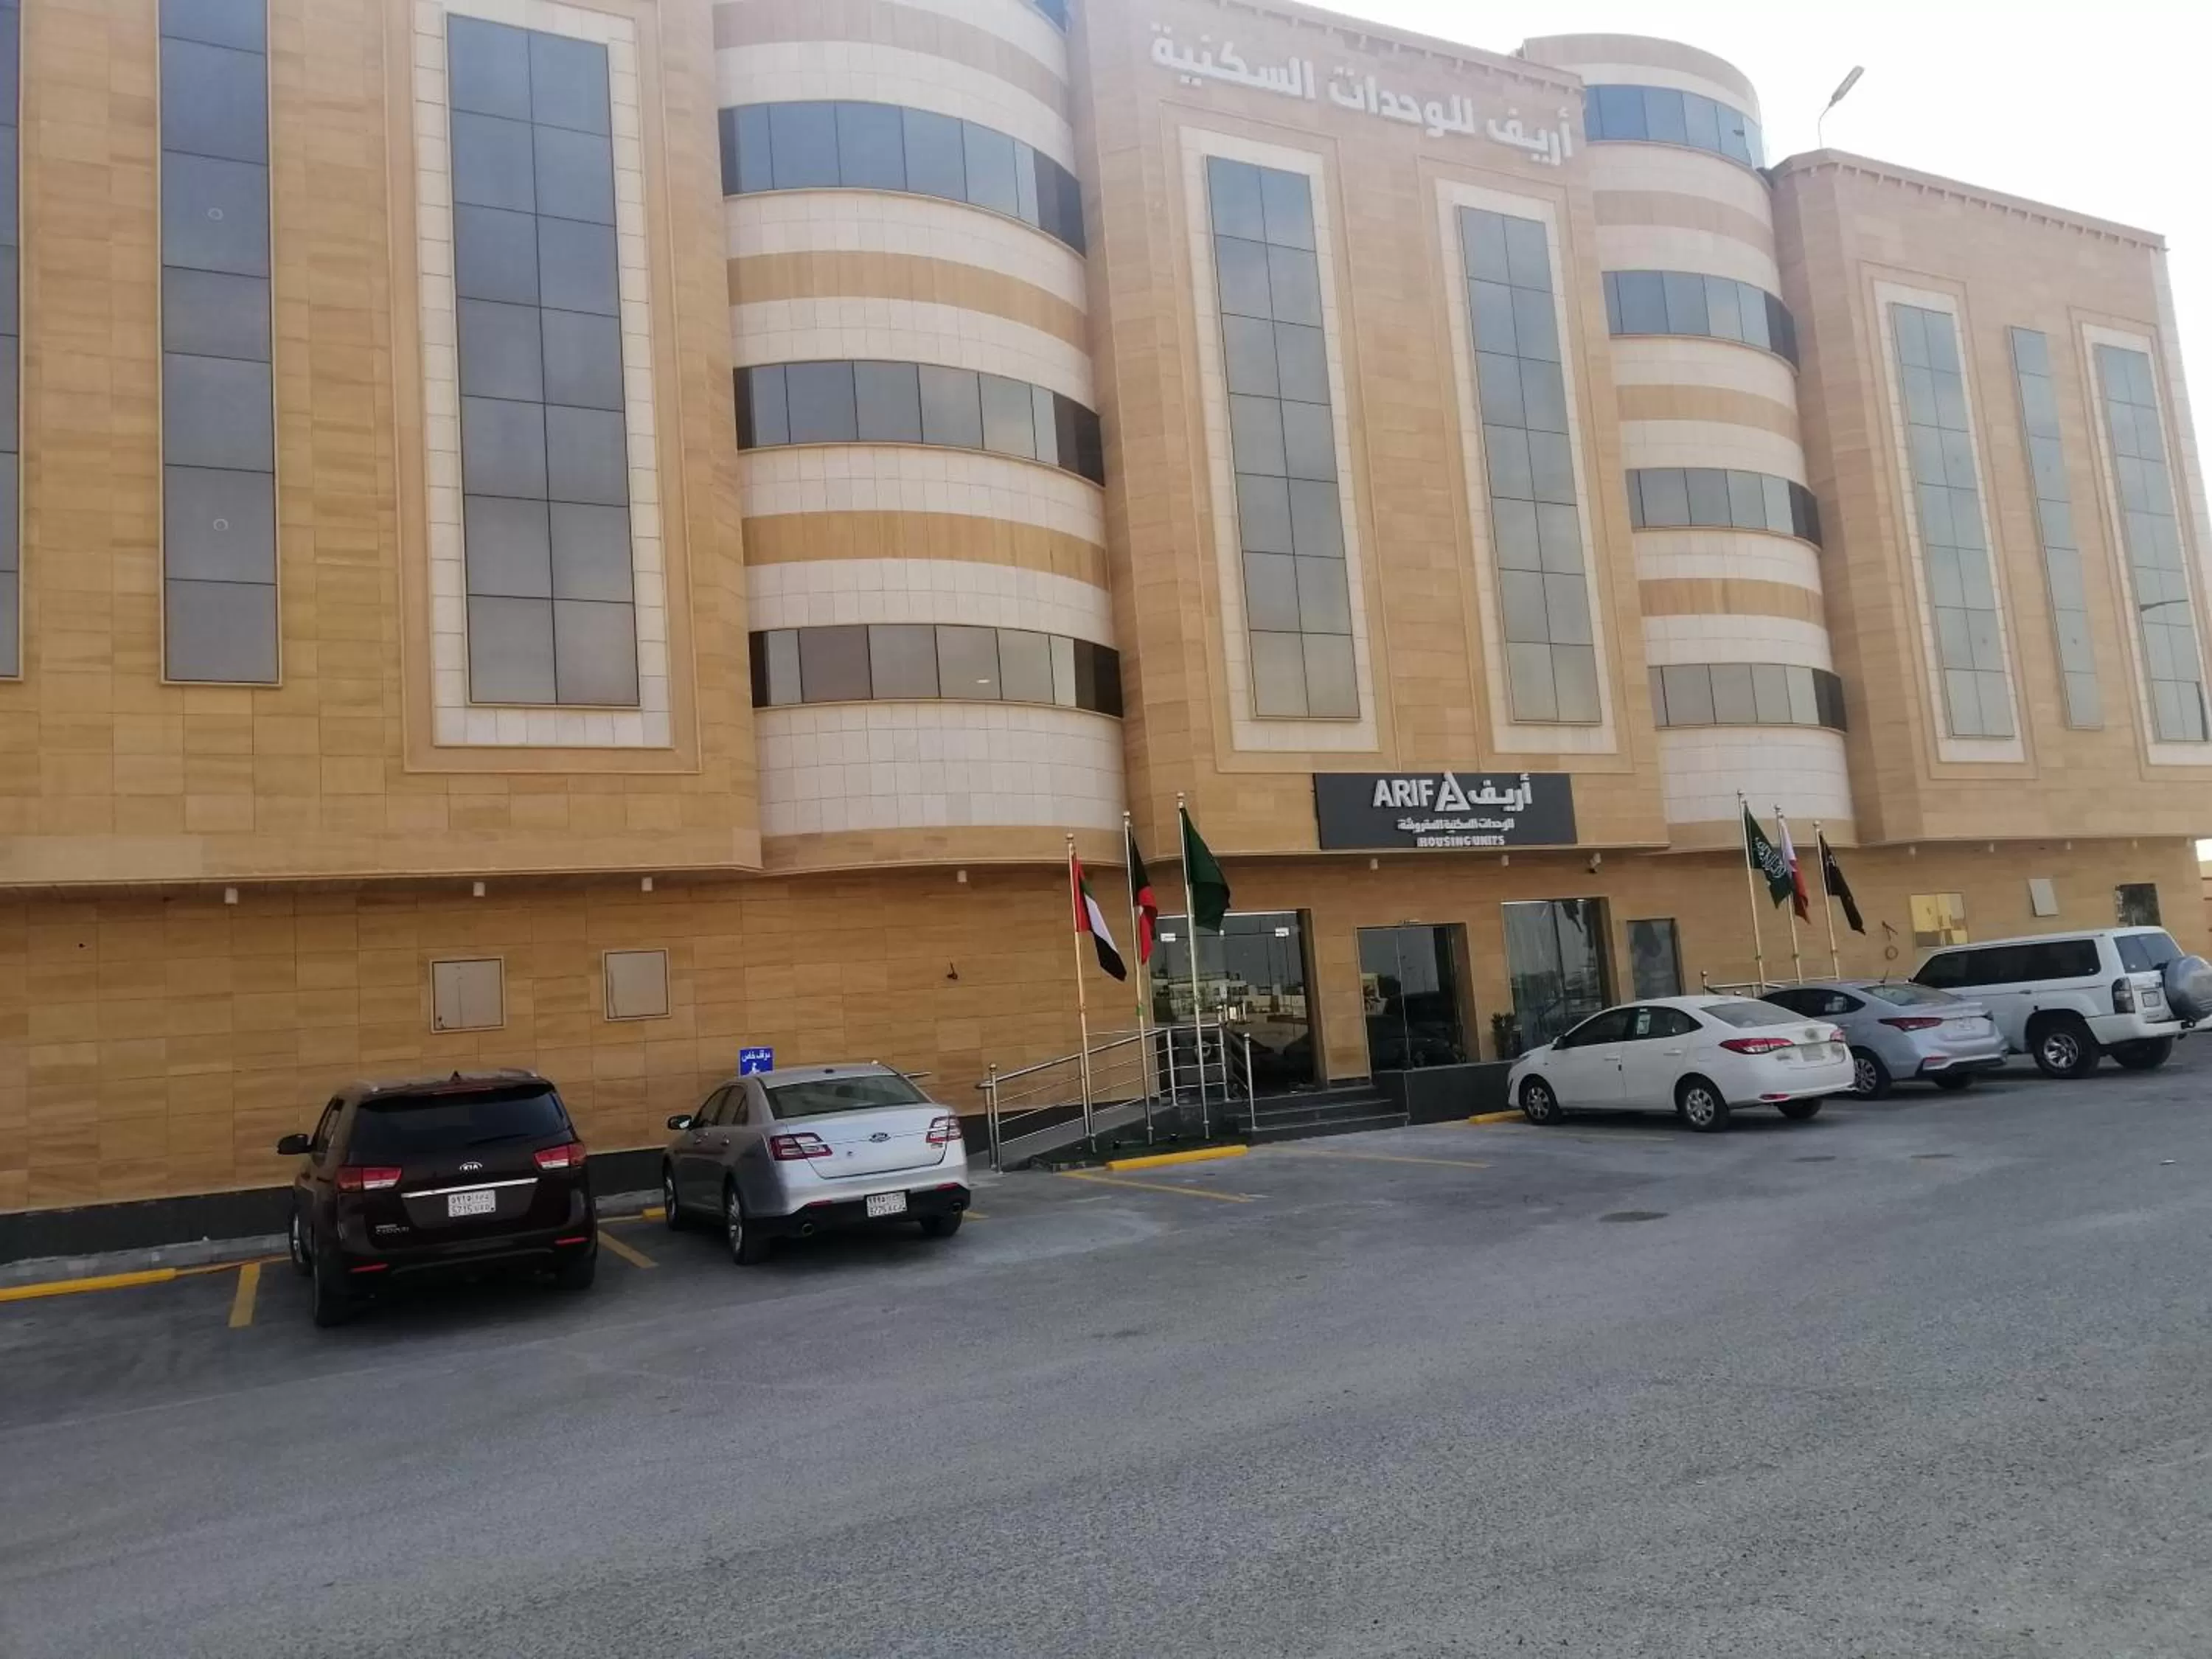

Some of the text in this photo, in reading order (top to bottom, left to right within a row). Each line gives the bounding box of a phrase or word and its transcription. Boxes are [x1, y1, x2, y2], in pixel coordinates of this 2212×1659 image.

[1150, 23, 1574, 167] أريف للوحدات السكنية
[1372, 779, 1434, 808] ARIF
[1467, 773, 1533, 812] أريف
[1416, 835, 1506, 847] HOUSING UNITS
